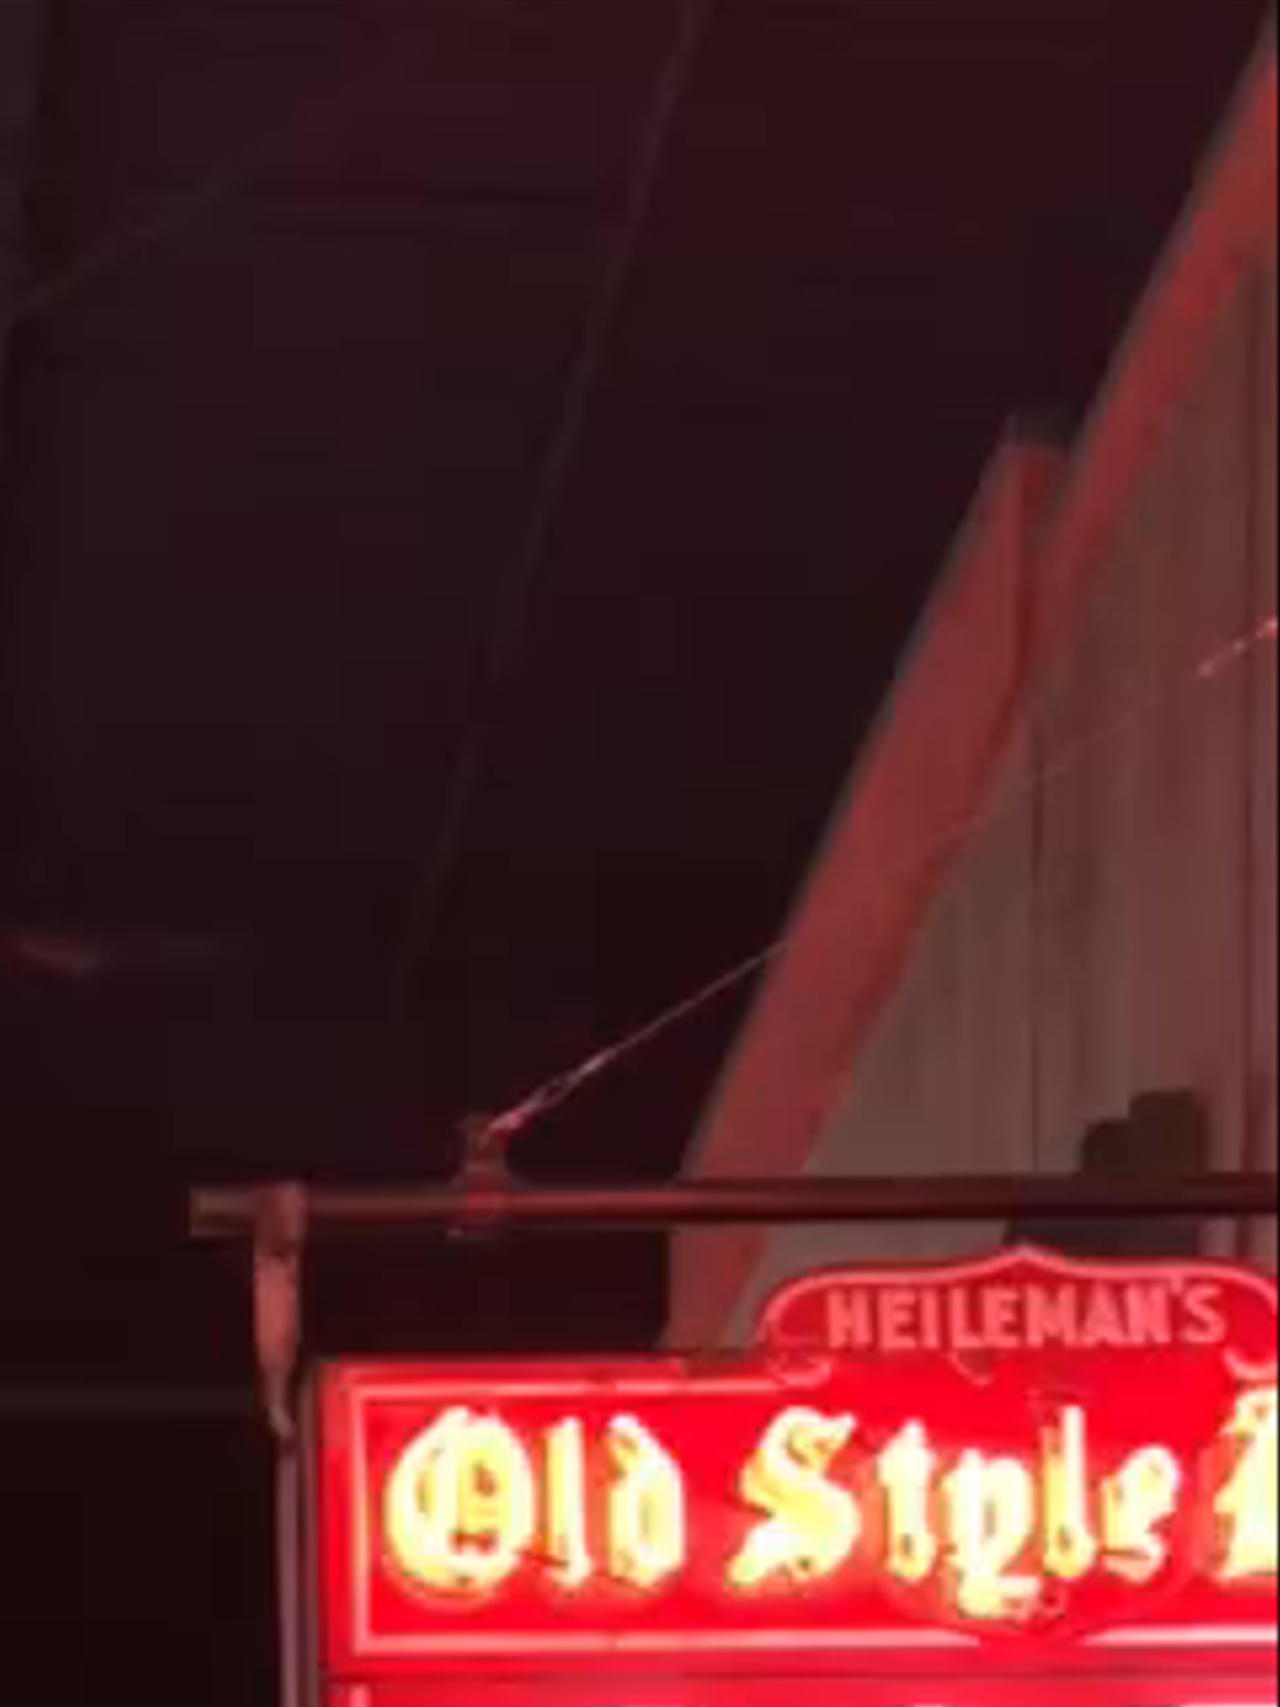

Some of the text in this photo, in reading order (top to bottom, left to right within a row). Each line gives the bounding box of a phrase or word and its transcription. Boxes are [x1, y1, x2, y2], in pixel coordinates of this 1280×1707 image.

[825, 1284, 1228, 1352] HEILEMAN'S
[382, 1403, 687, 1596] Old
[725, 1402, 1182, 1624] Style
